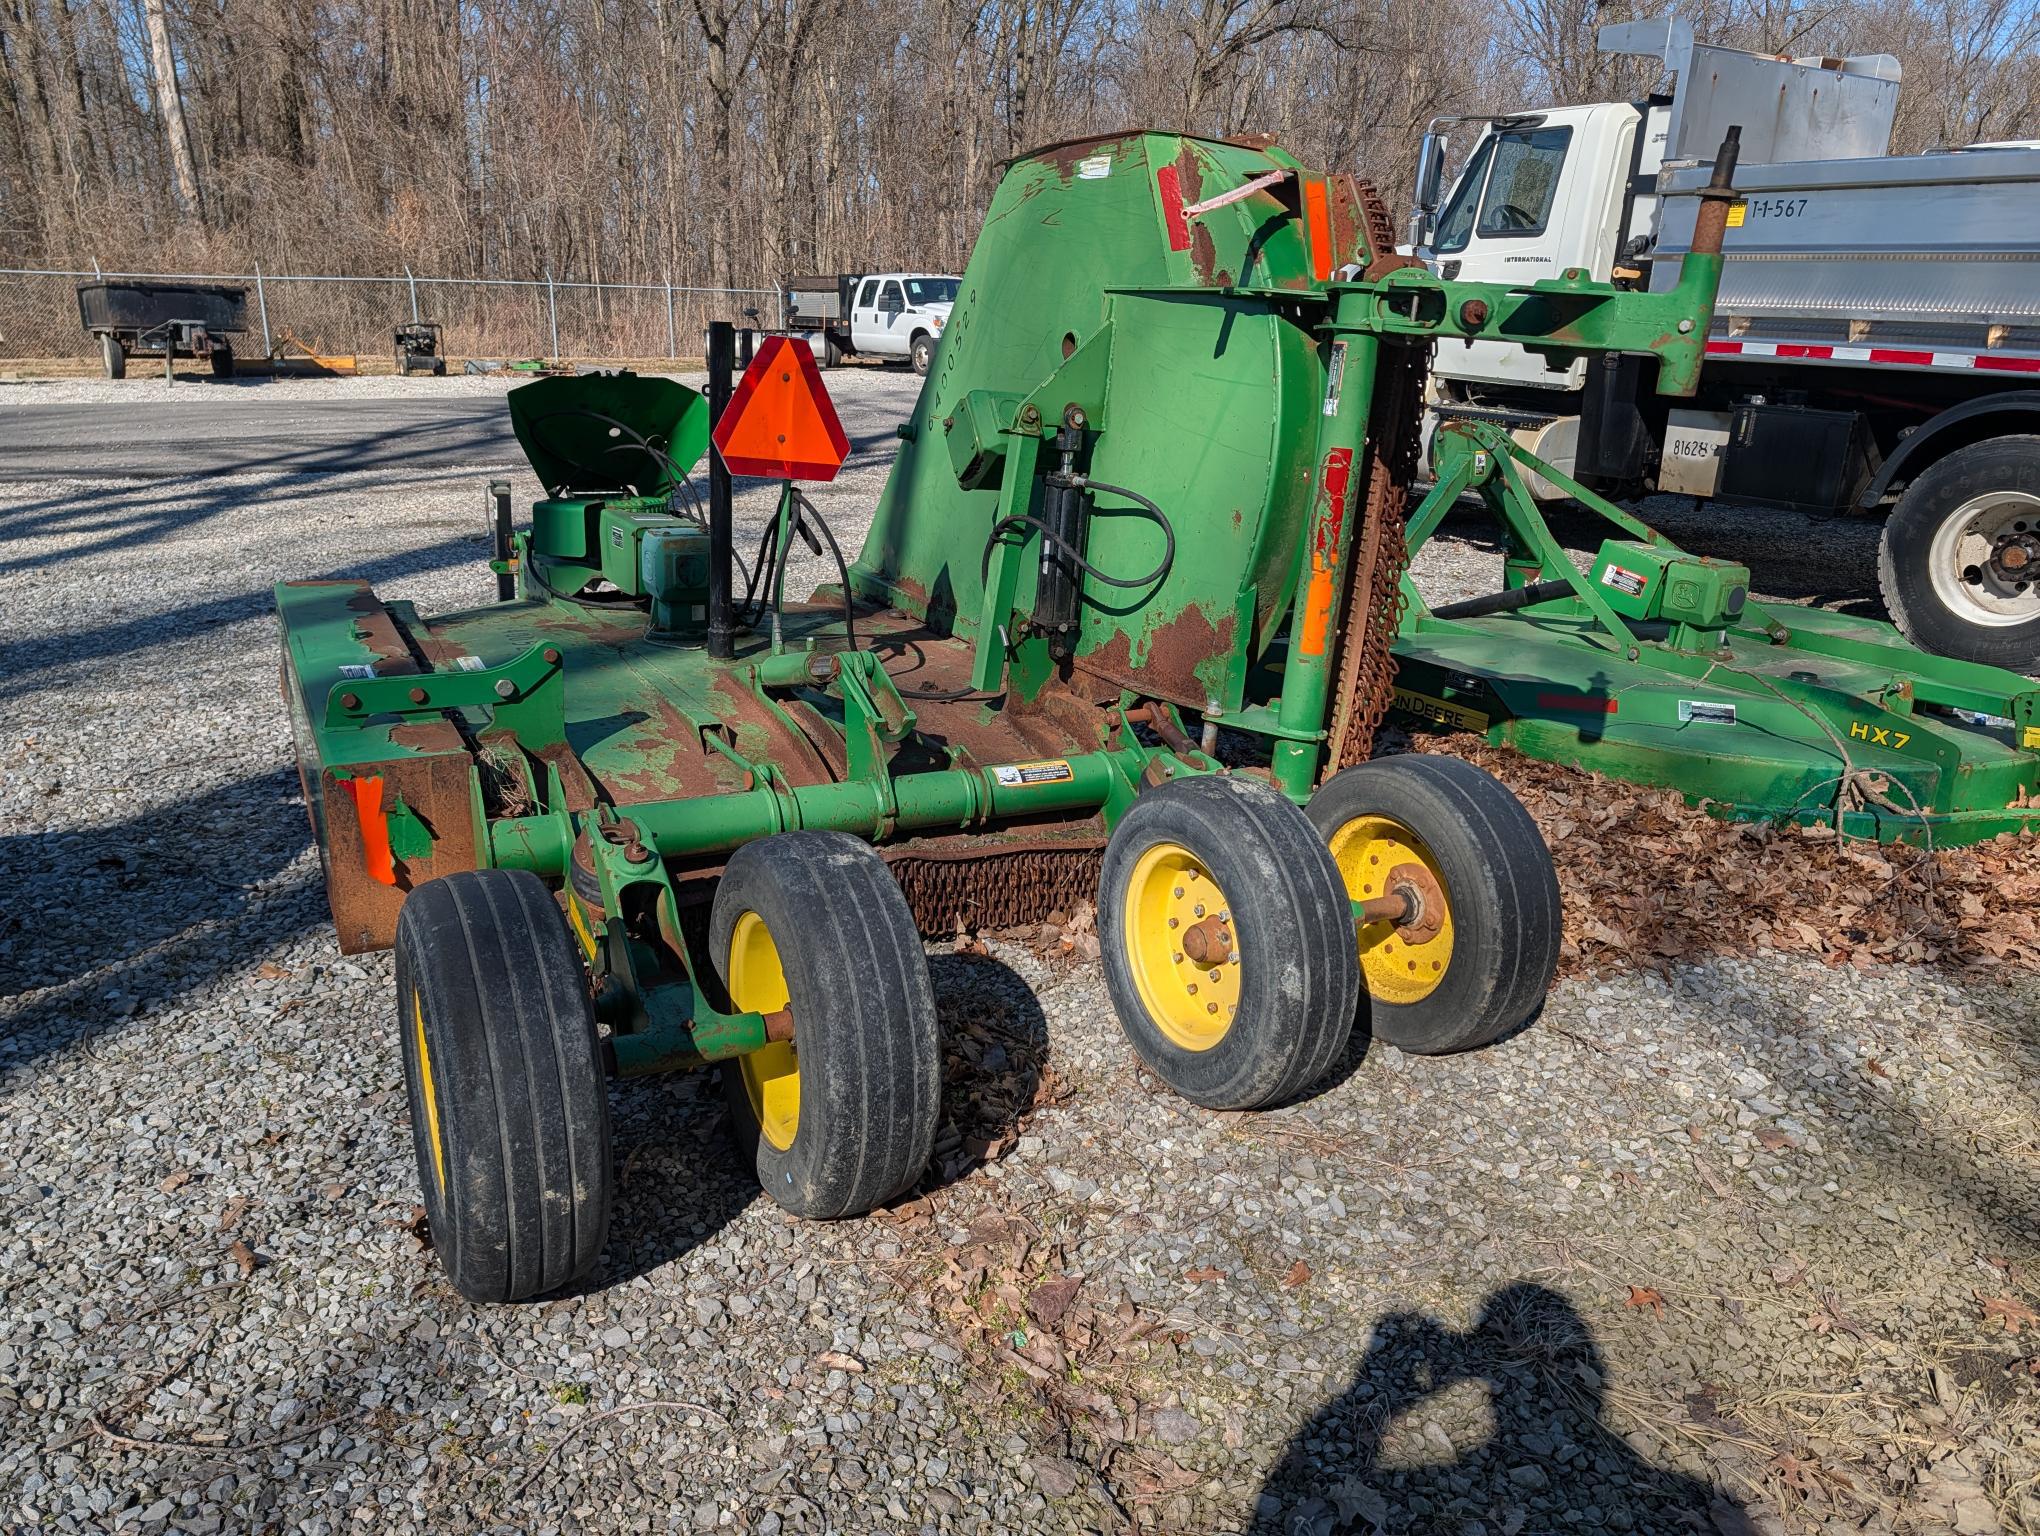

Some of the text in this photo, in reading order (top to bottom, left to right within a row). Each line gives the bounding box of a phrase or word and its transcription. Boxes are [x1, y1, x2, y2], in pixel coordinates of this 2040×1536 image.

[1752, 199, 1808, 218] T-1-567
[1412, 696, 1465, 727] DEERE
[1849, 720, 1912, 749] HX7
